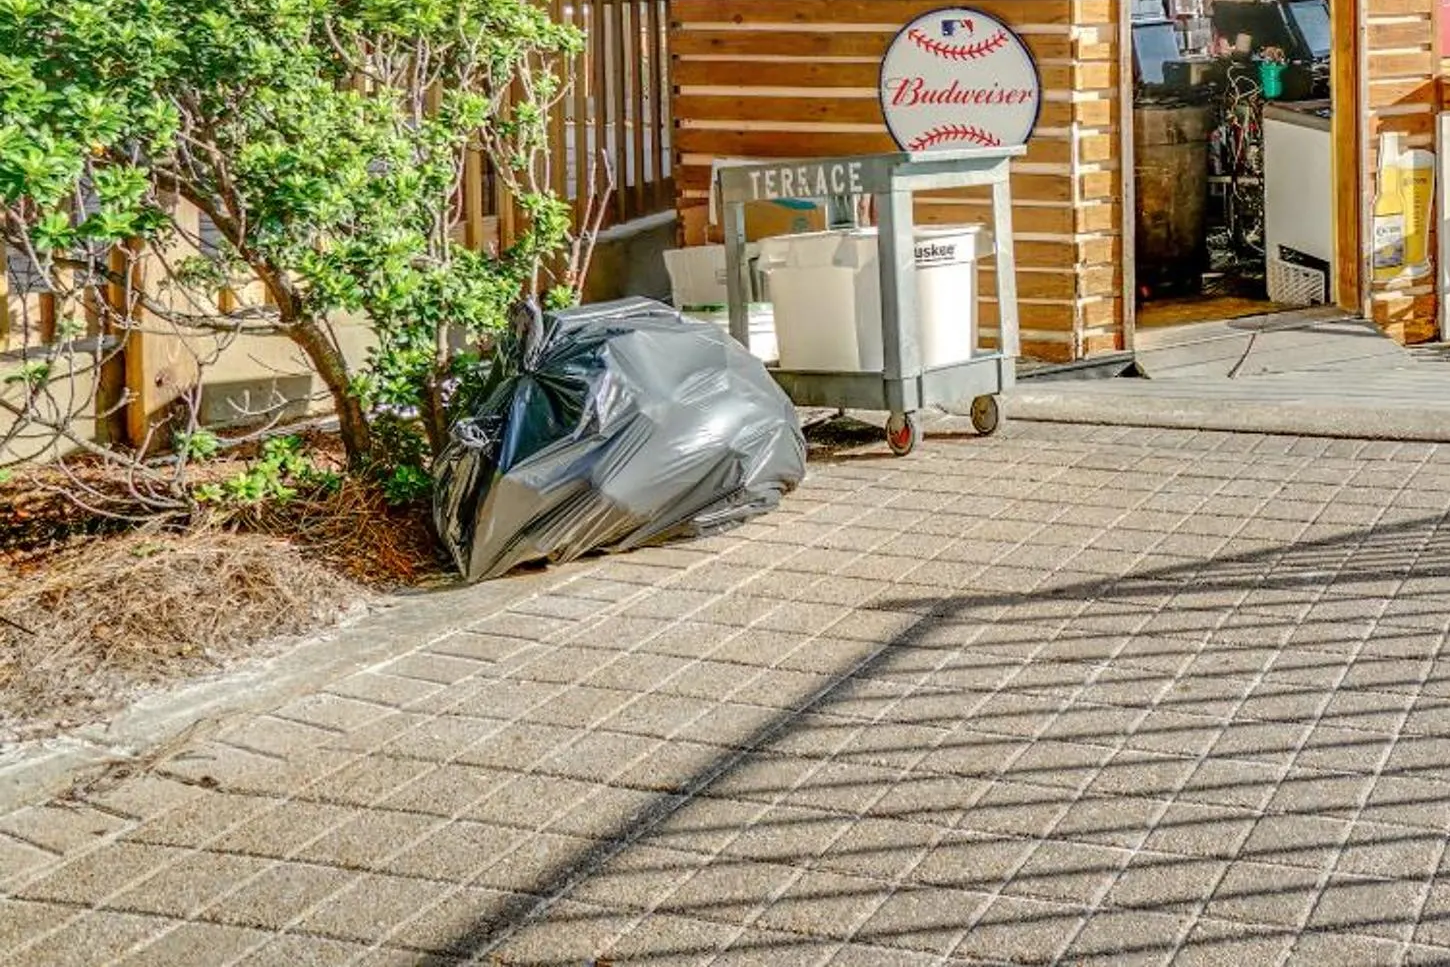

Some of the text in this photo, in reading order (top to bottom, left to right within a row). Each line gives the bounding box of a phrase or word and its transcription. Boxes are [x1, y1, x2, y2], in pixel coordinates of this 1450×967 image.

[886, 77, 1033, 108] Budweiser
[749, 162, 863, 198] TERRACE
[914, 243, 955, 258] uskee
